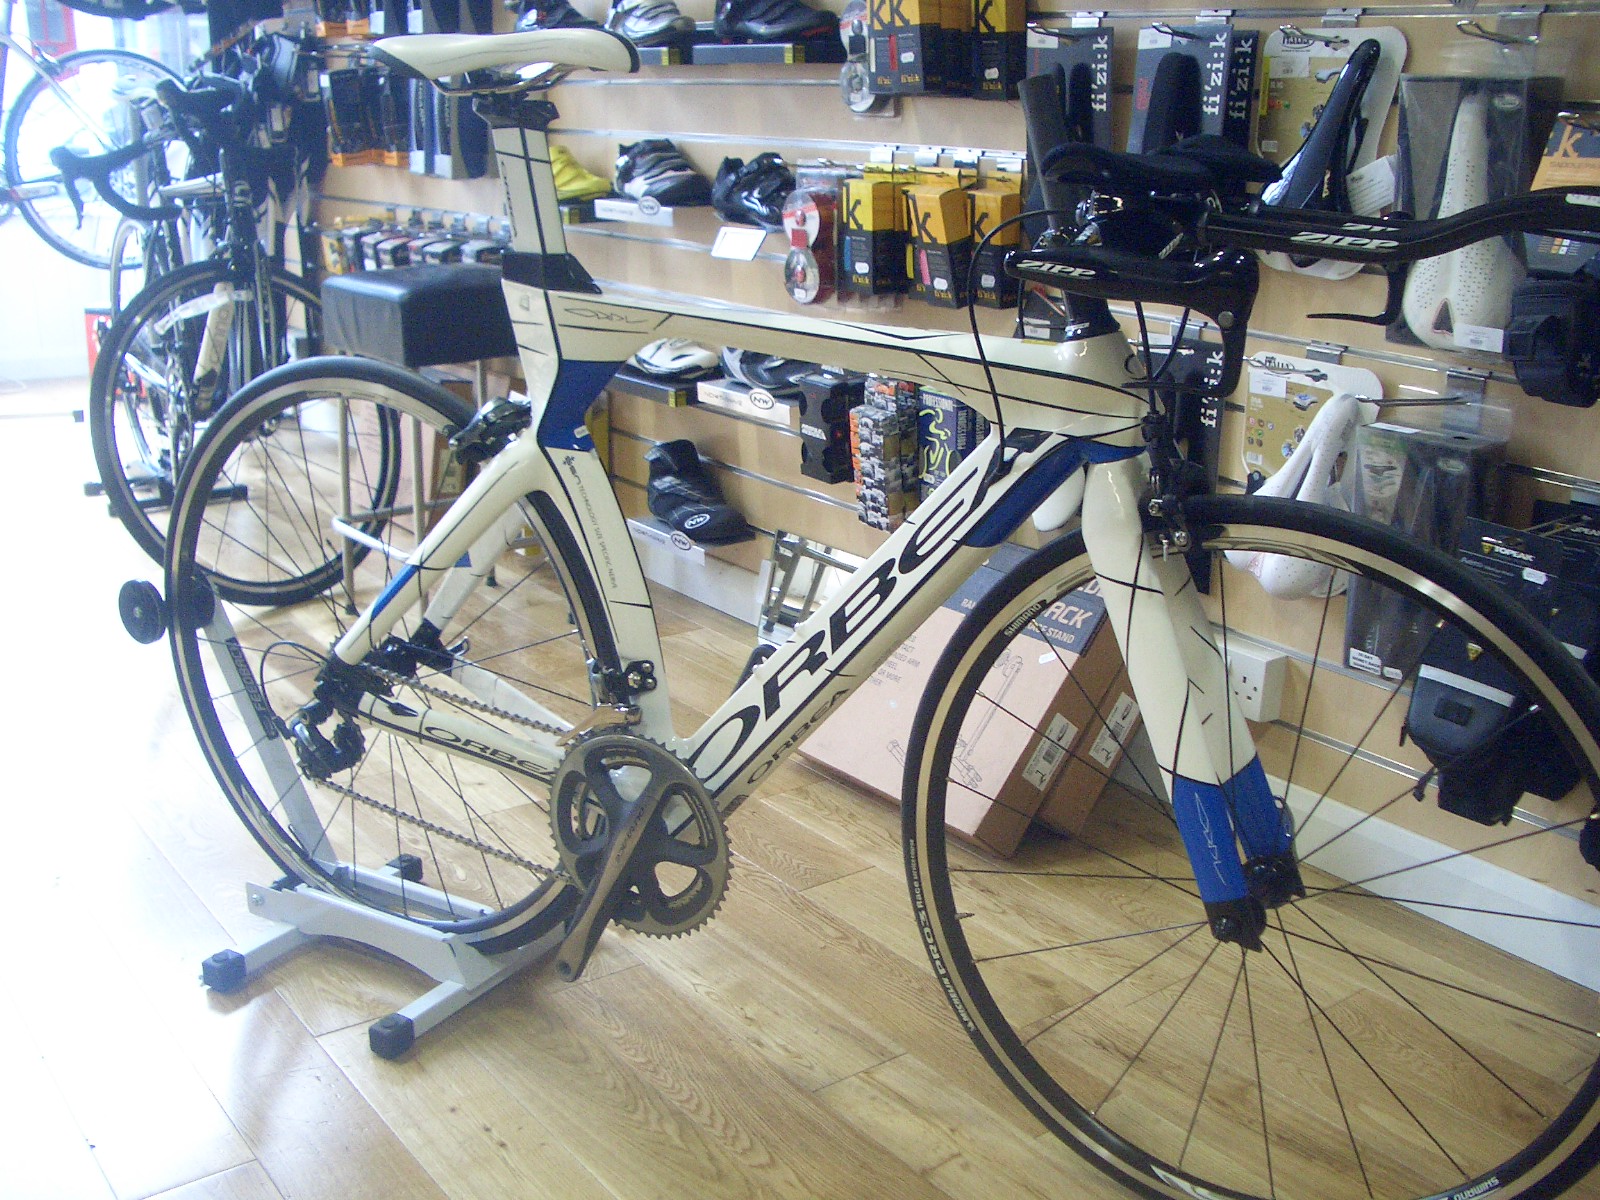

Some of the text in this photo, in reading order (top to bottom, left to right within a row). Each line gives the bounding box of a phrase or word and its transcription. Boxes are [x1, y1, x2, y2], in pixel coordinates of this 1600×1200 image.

[1290, 231, 1400, 250] ZIPP
[1016, 259, 1096, 279] ZIPP
[1494, 545, 1536, 562] TOPEAK
[1004, 602, 1042, 637] SHIMANO
[1043, 601, 1093, 629] ACK
[747, 688, 850, 785] ORBEA
